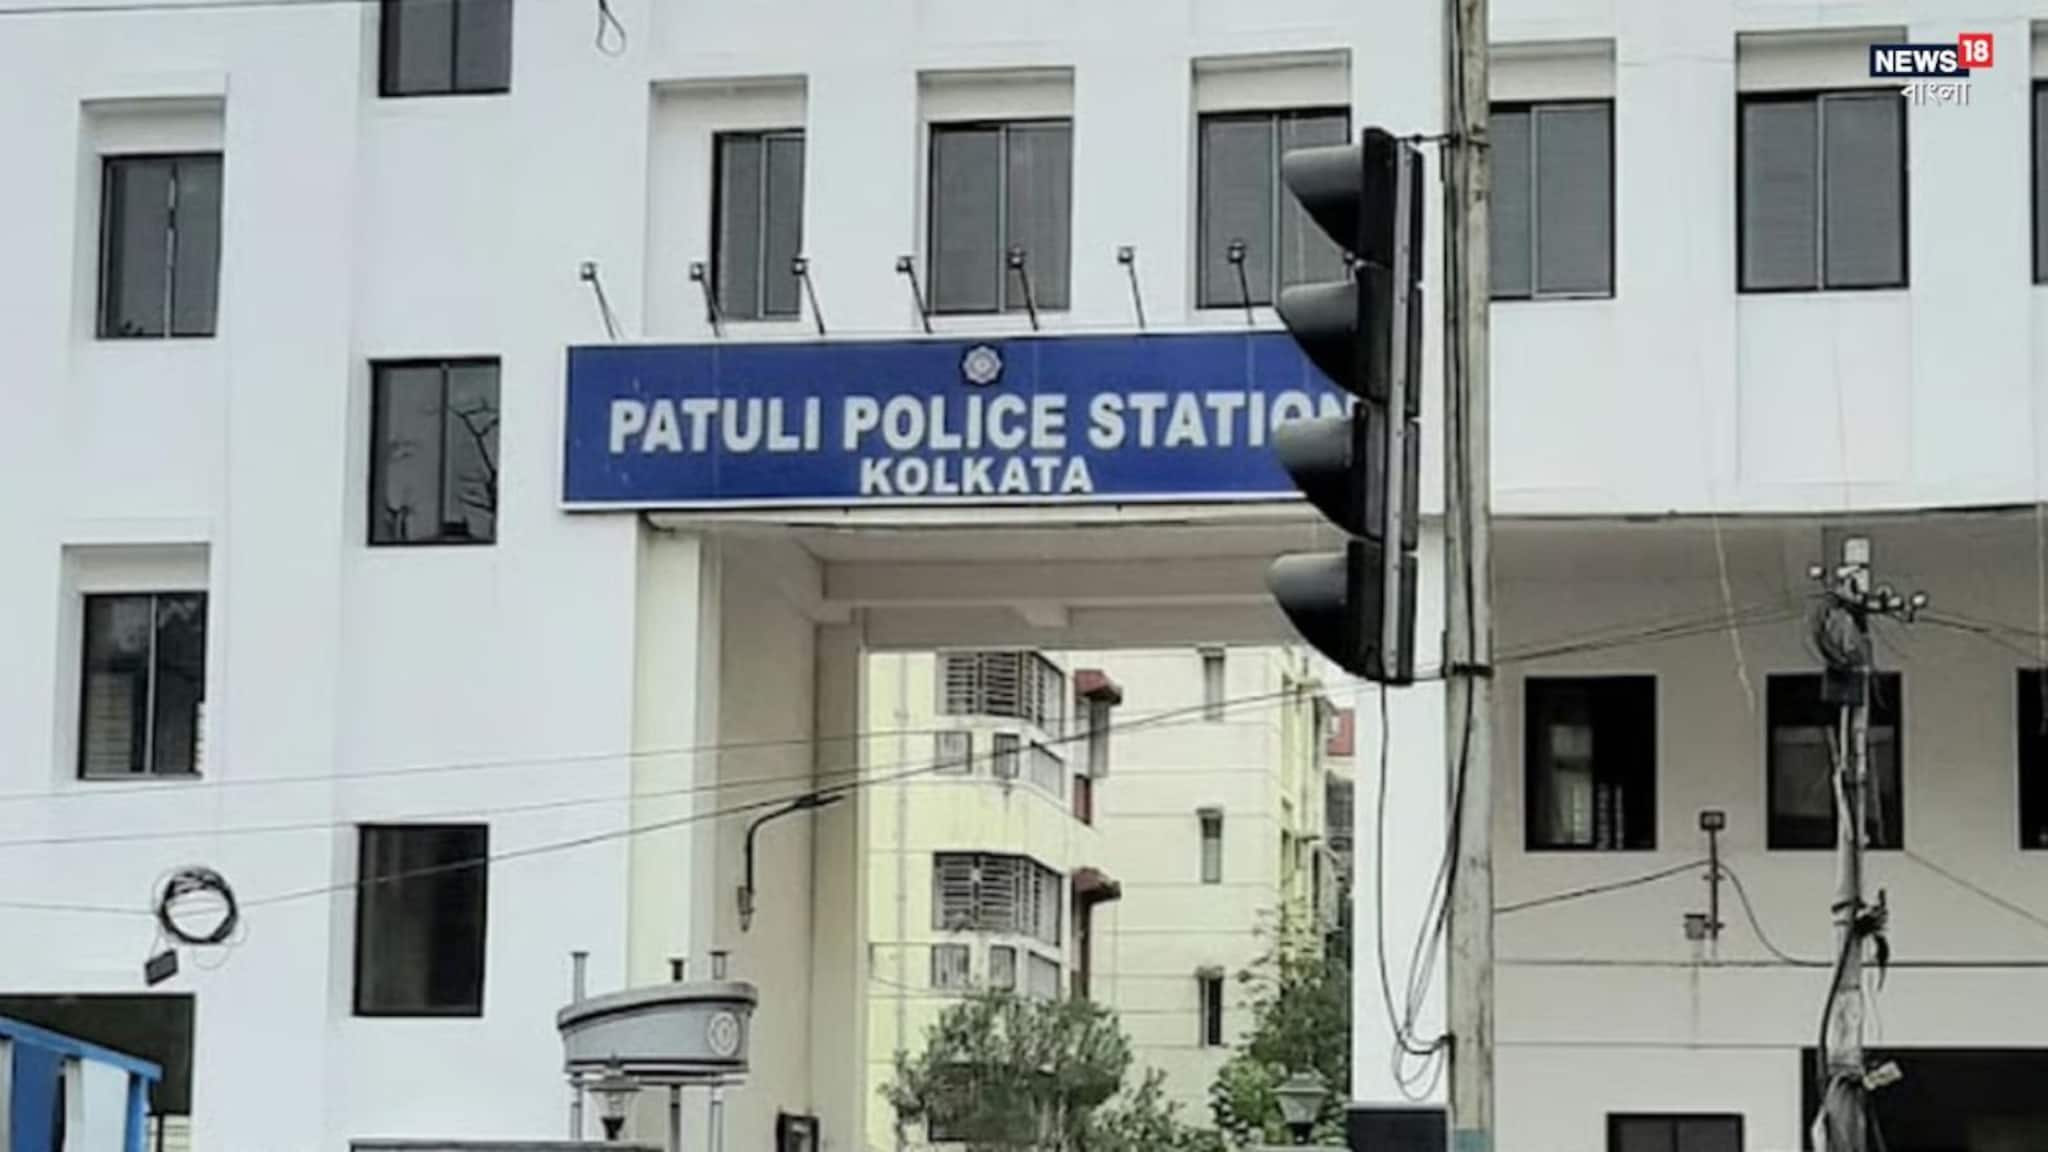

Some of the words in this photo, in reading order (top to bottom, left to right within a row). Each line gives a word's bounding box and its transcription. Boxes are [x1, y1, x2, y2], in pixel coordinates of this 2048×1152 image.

[609, 397, 821, 454] PATULI
[843, 394, 1067, 450] POLICE
[860, 455, 1094, 495] KOLKATA
